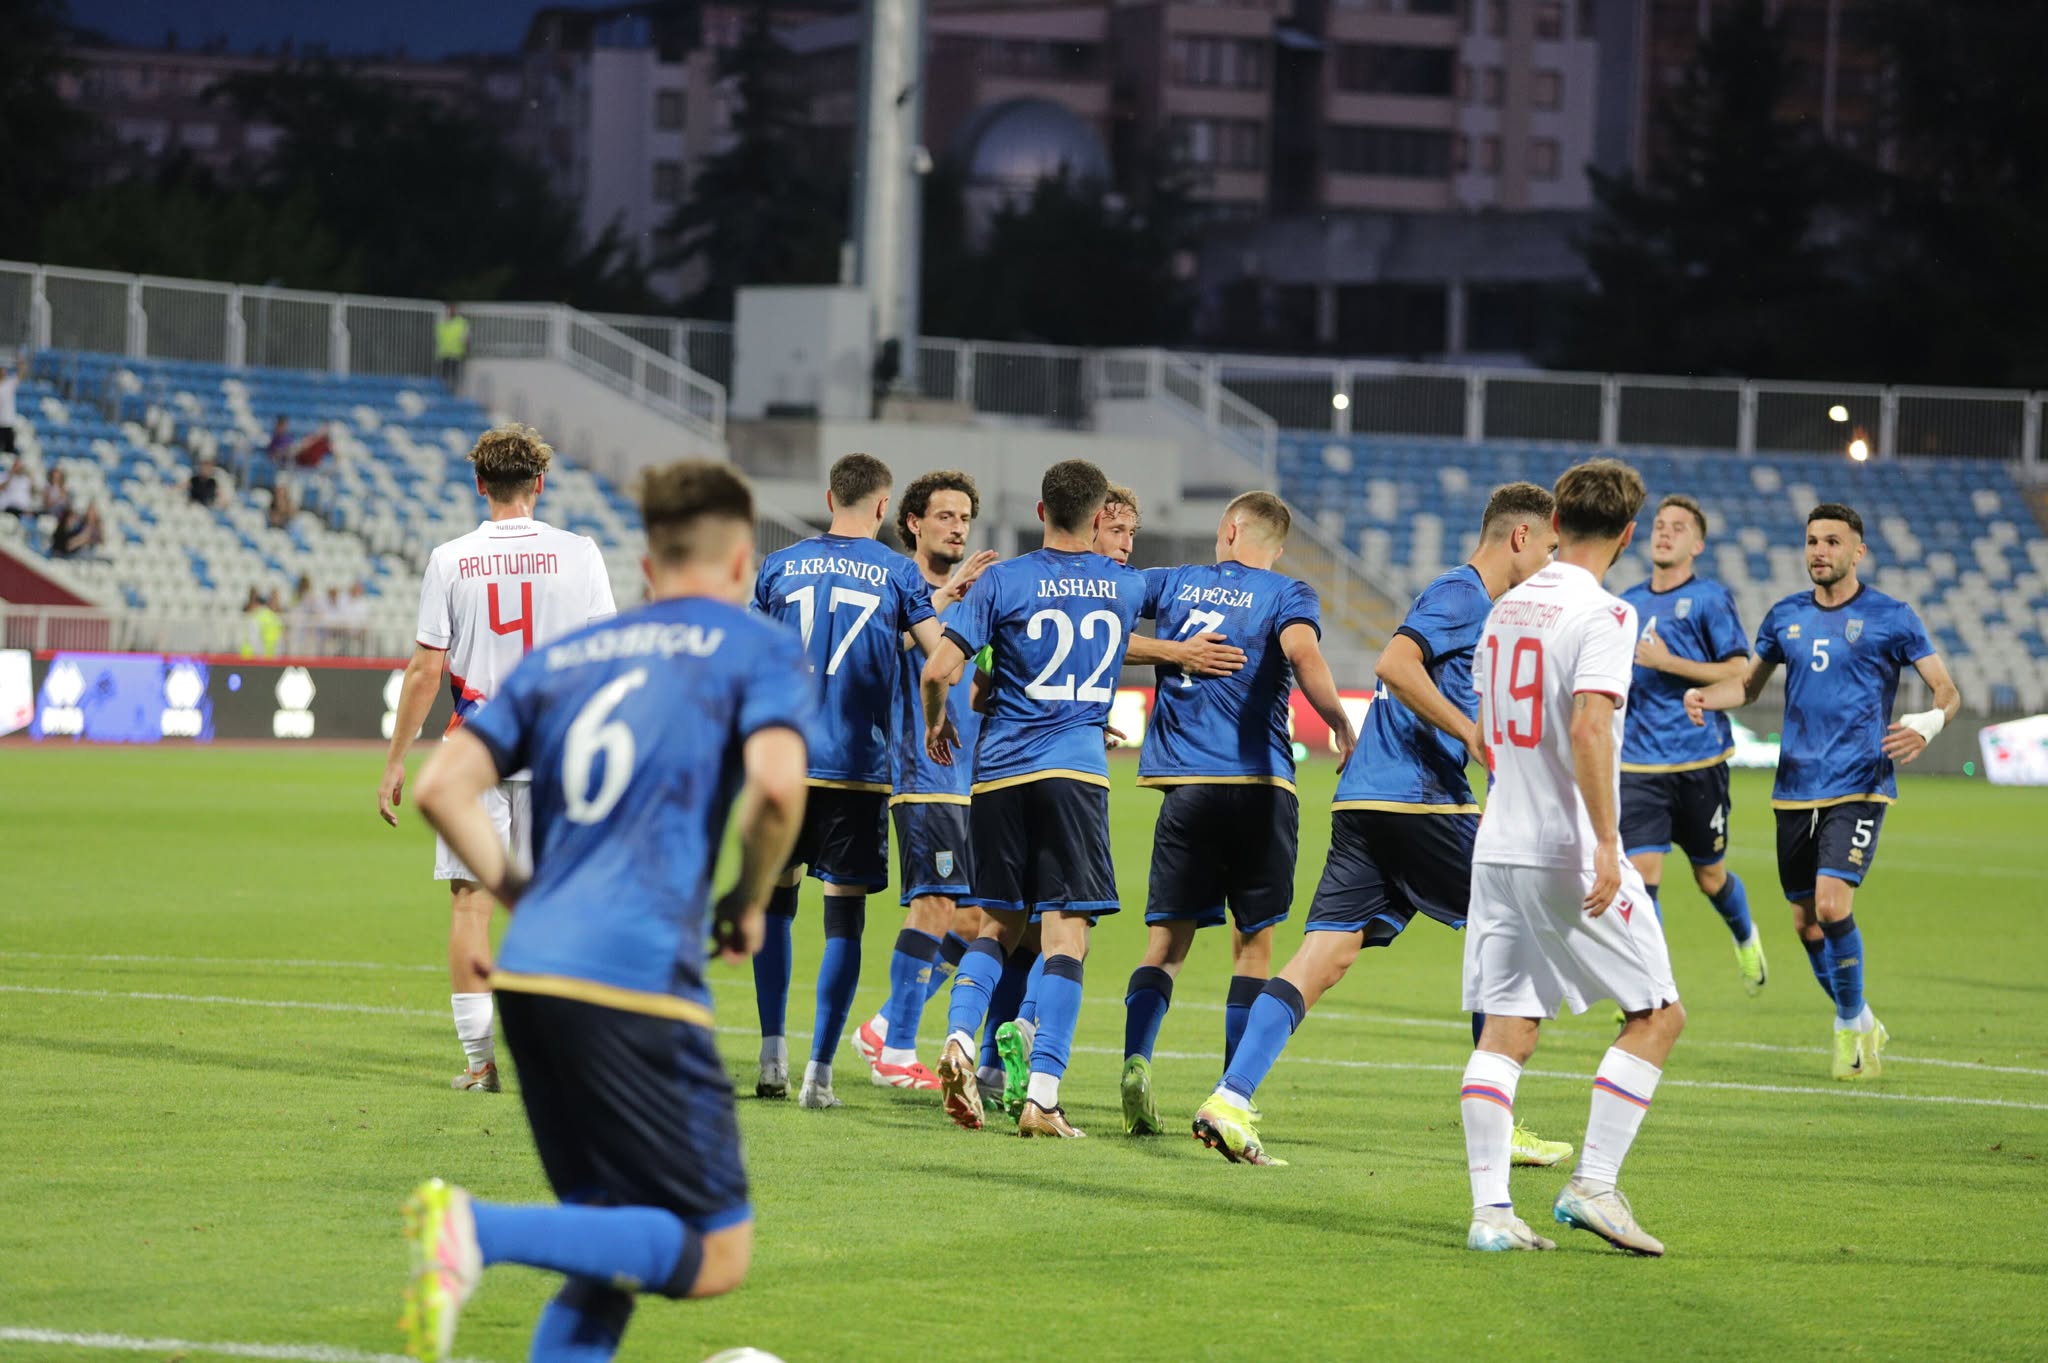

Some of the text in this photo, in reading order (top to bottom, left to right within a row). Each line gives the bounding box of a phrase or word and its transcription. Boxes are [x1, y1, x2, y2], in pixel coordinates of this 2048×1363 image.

[459, 553, 558, 580] ARUTIUNIAN
[784, 557, 889, 586] E.KRASNIQI
[1037, 579, 1117, 599] JASHARI
[487, 582, 533, 657] 4
[785, 585, 880, 675] 17
[1024, 609, 1121, 703] 22
[1811, 639, 1830, 672] 5
[1487, 635, 1543, 749] 19
[562, 667, 648, 825] 6
[1709, 804, 1725, 834] 4
[1851, 819, 1874, 848] 5
